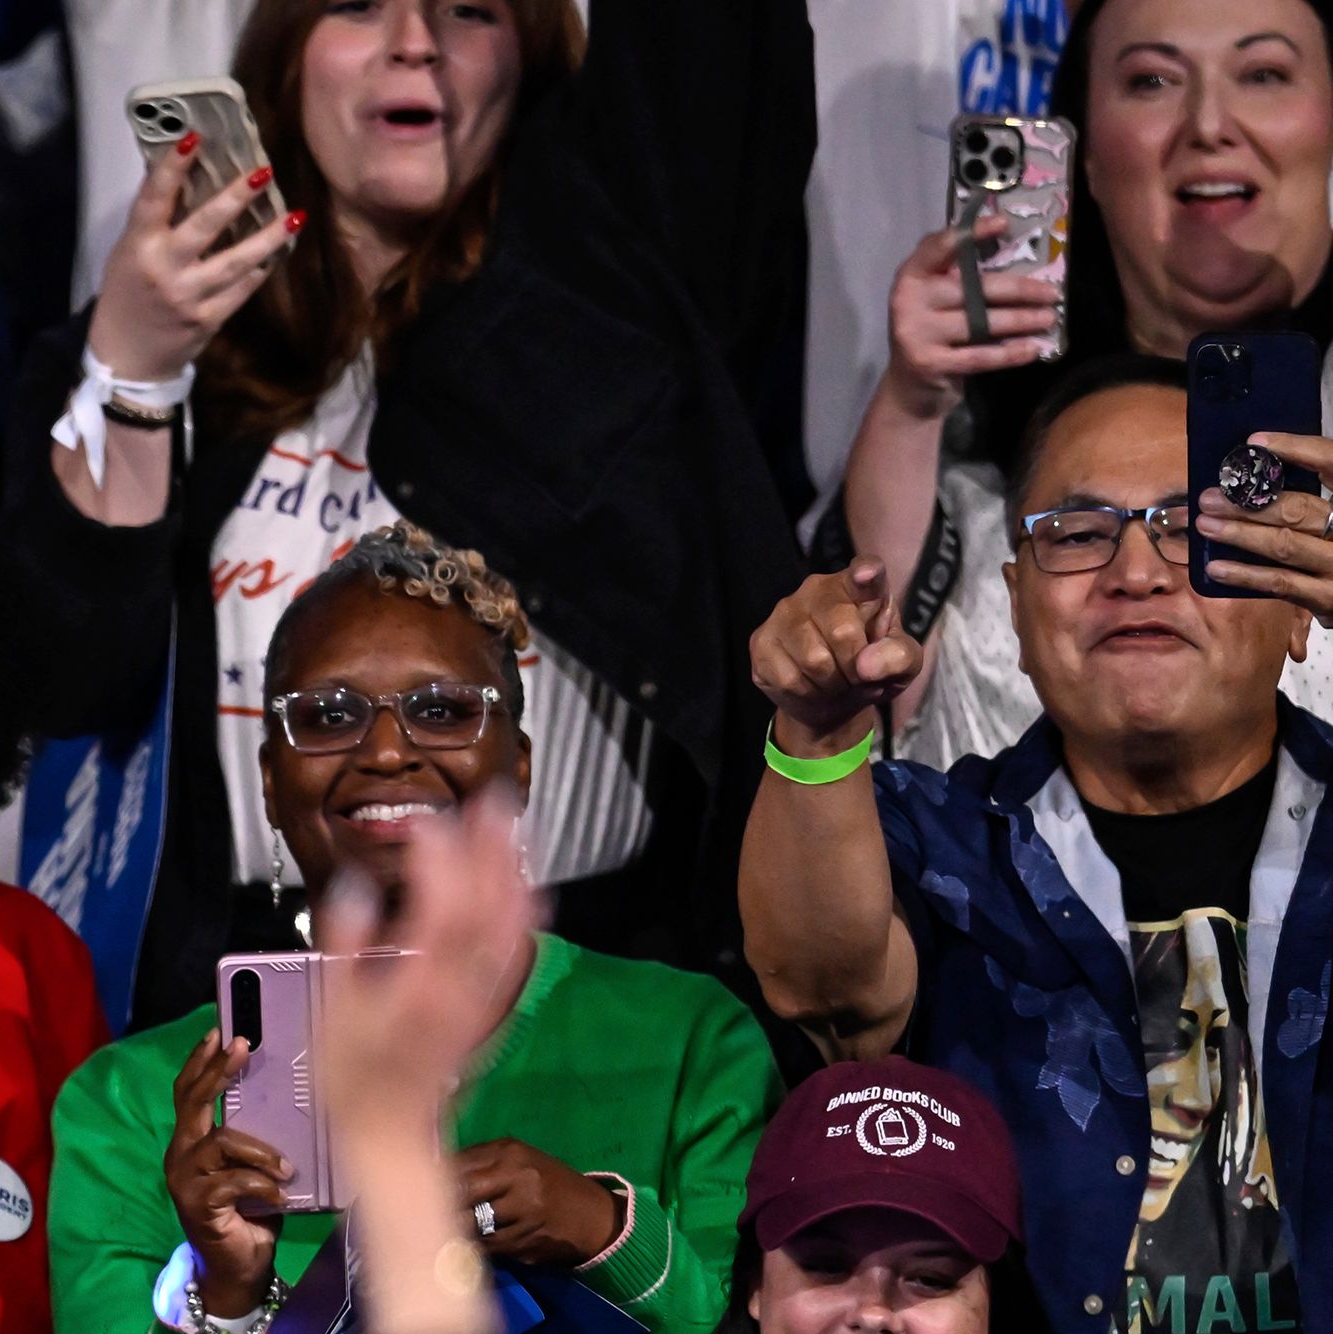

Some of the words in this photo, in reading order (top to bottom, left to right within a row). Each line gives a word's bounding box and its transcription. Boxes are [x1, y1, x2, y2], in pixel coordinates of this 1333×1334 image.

[826, 1086, 881, 1112] BANNED
[882, 1087, 929, 1108] BOOKS
[930, 1098, 961, 1127] CLUB
[826, 1124, 852, 1138] EST.
[931, 1132, 956, 1152] 1920
